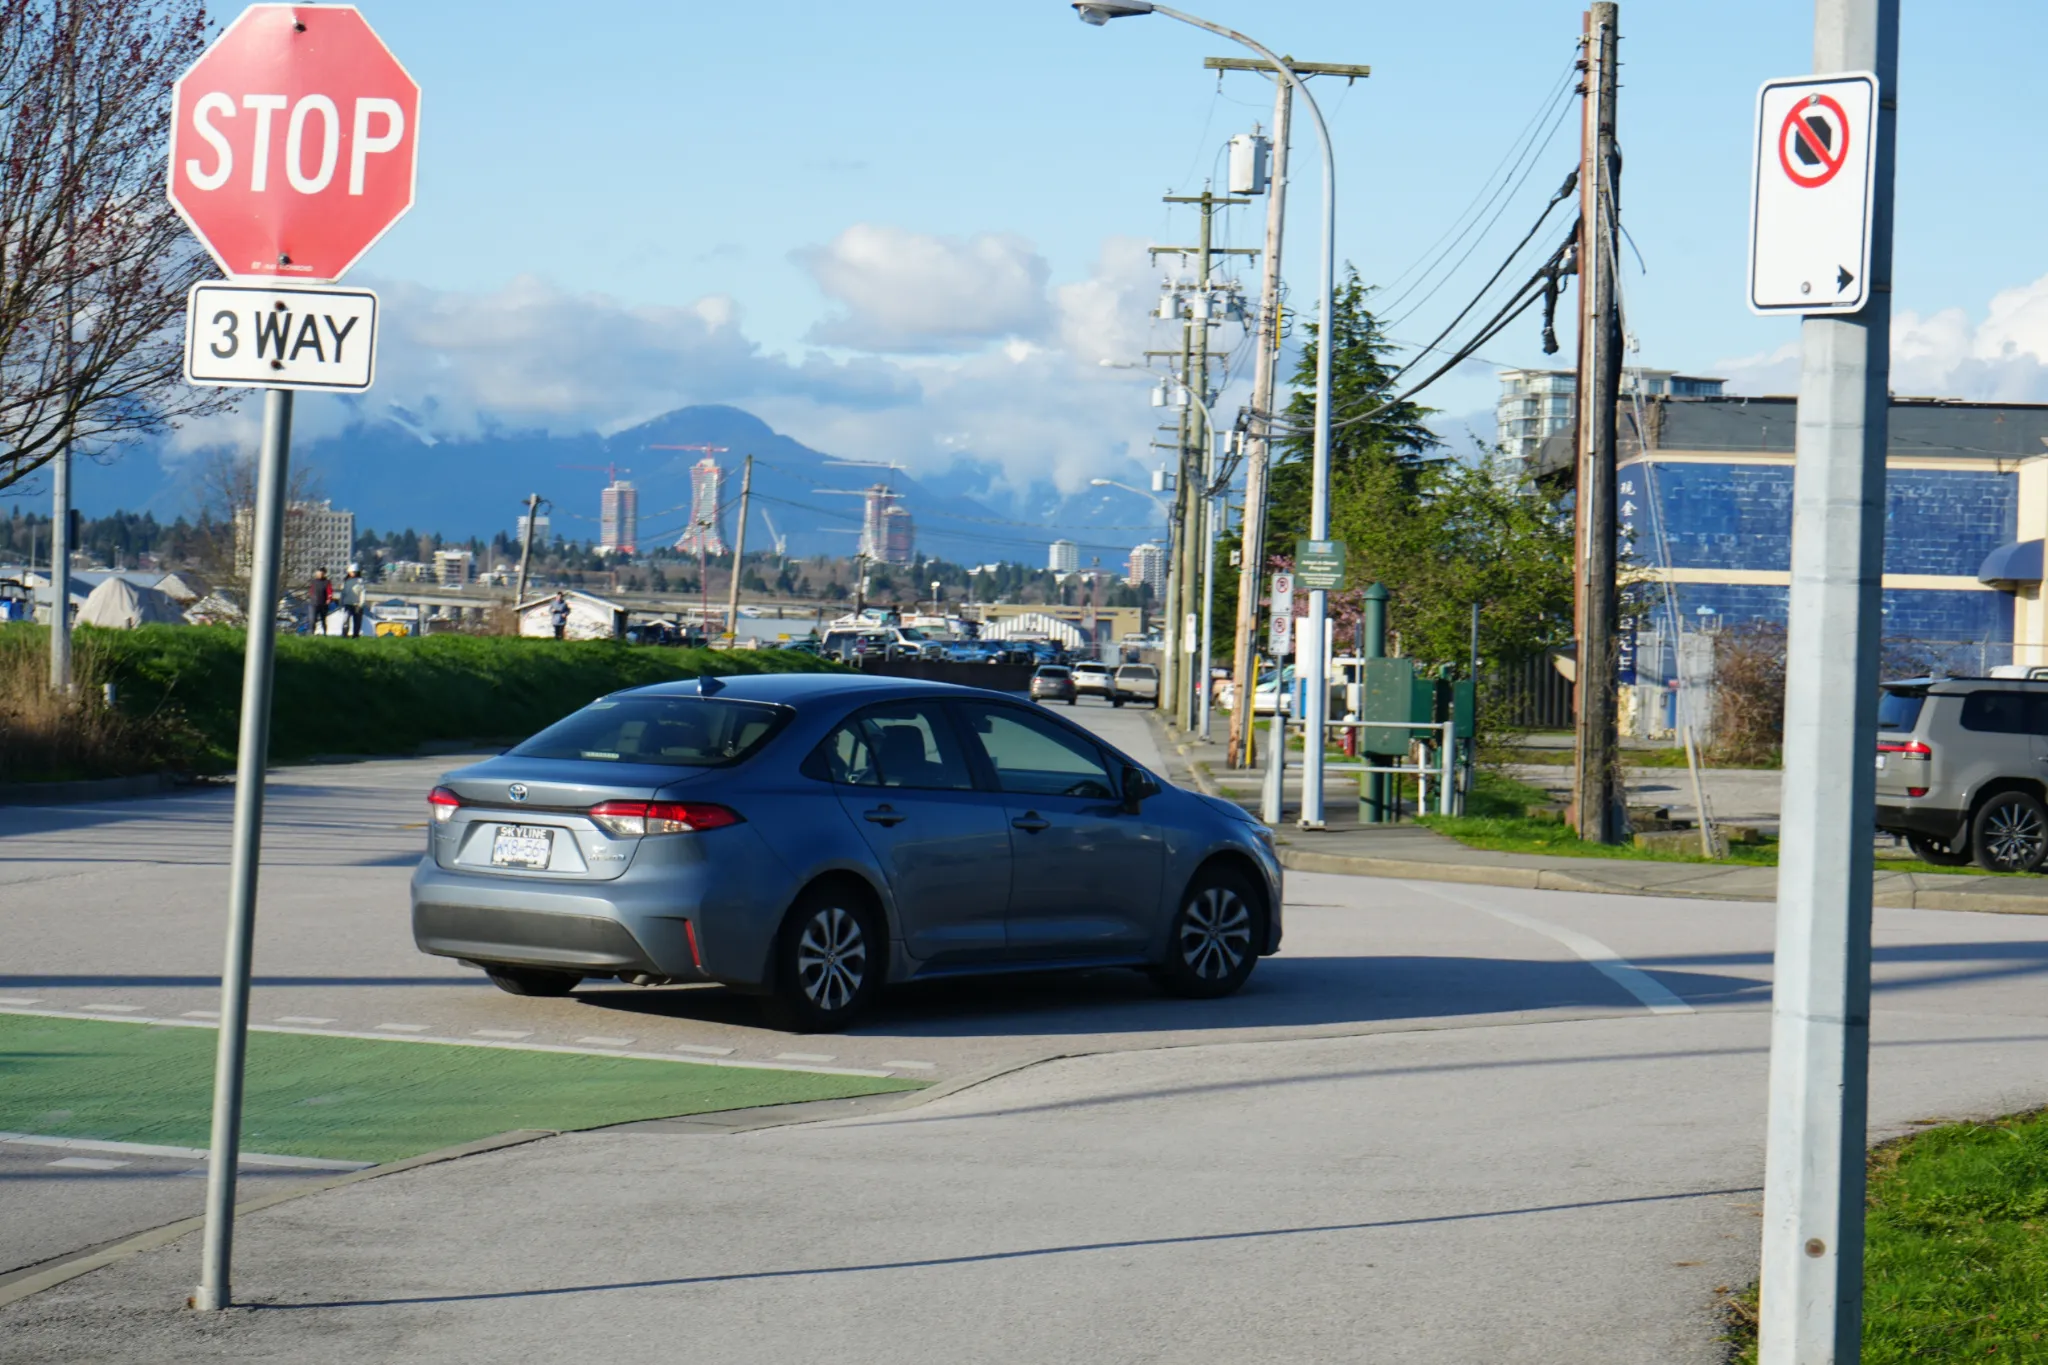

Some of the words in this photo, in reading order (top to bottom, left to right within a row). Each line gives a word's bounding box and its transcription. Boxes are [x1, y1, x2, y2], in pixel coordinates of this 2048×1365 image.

[185, 91, 405, 196] STOP
[209, 309, 240, 360] 3
[254, 310, 359, 364] WAY
[500, 827, 547, 840] SKYLINE
